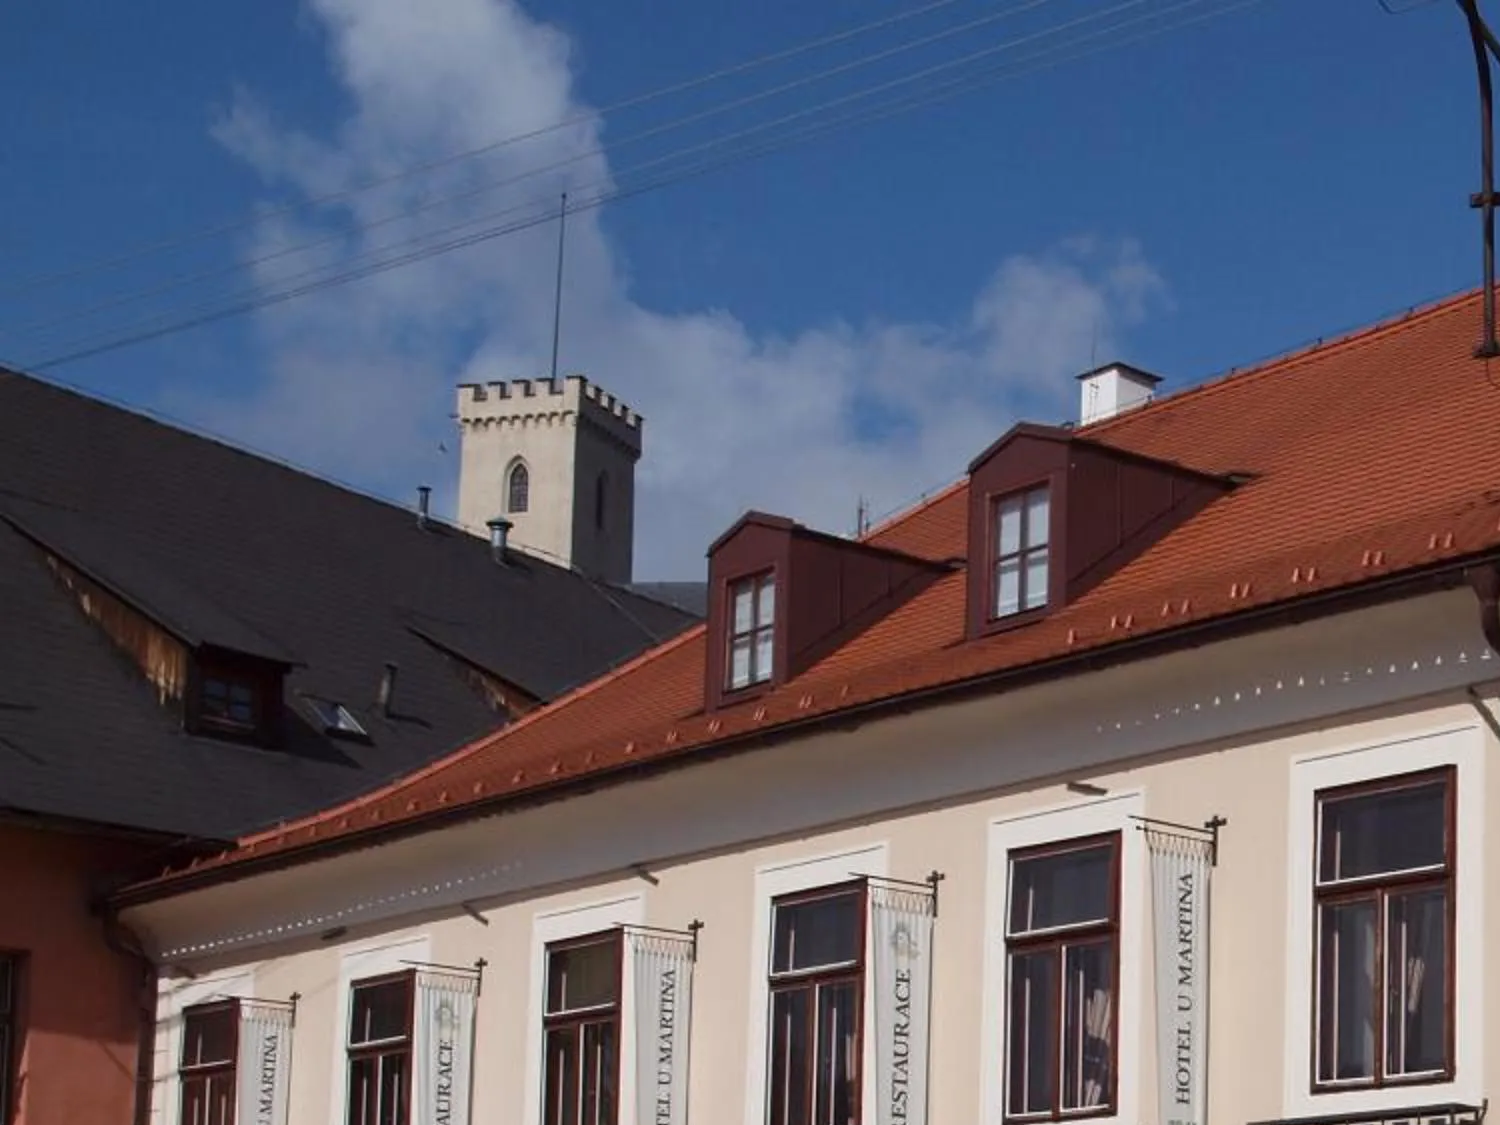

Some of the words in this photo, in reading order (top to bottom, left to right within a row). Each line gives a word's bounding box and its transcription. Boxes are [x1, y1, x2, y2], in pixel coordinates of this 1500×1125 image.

[1177, 872, 1194, 987] MARTINA
[658, 969, 677, 1067] MARTINA
[1177, 994, 1192, 1012] U
[257, 1034, 279, 1116] MARTINA
[658, 1071, 672, 1087] U
[1175, 1021, 1192, 1105] HOTEL
